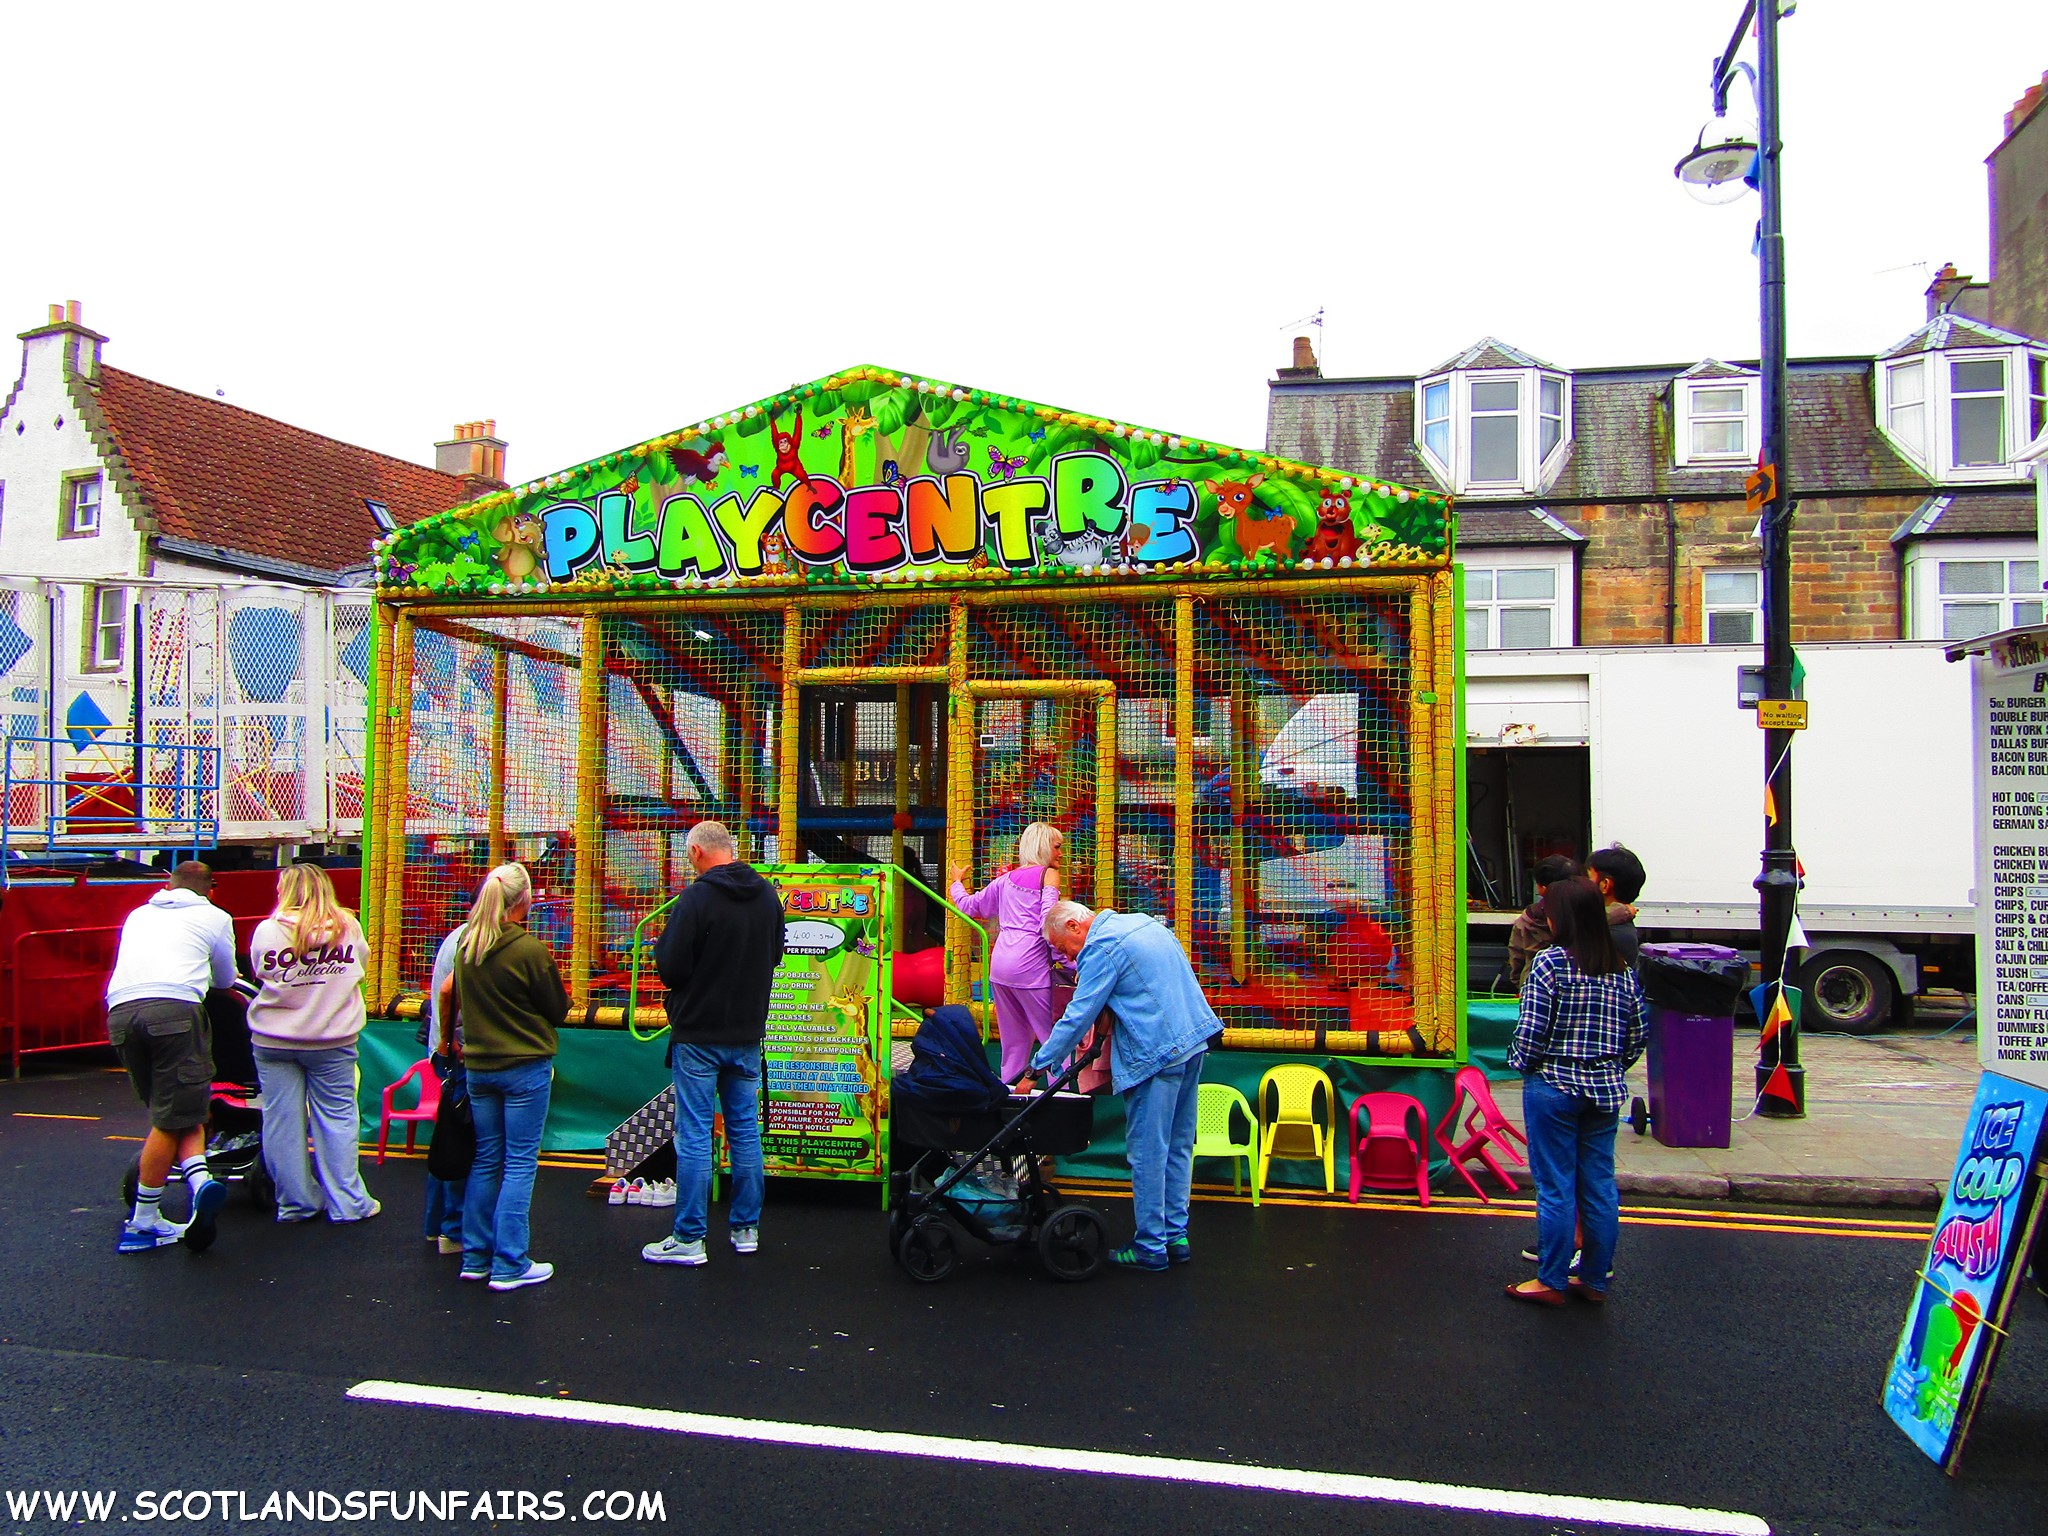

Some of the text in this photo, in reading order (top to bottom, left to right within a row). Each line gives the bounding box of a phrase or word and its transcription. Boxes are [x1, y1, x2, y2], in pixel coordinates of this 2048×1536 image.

[542, 451, 1197, 584] PLAYCENTRE
[2009, 641, 2040, 668] SLUSH
[2007, 697, 2046, 708] BURGER
[1990, 712, 2027, 722] DOUBLE
[1990, 725, 2042, 735] NEW YORK
[1991, 739, 2028, 749] DALLAS
[1991, 752, 2025, 762] BACON
[1992, 765, 2025, 776] BACON
[1992, 792, 2011, 802] HOT
[2015, 792, 2035, 802] DOG
[1992, 805, 2043, 816] FOOTLONG
[1993, 819, 2035, 829] GERMAN
[1993, 846, 2035, 856] CHICKEN
[1994, 859, 2036, 870] CHICKEN
[1994, 872, 2035, 883] NACHOS
[1994, 886, 2024, 897] CHIPS
[1994, 900, 2027, 912] CHIPS,
[1995, 913, 2024, 924] CHIPS
[2028, 914, 2036, 924] &
[1995, 927, 2028, 939] CHIPS,
[1995, 940, 2014, 950] SALT
[2018, 940, 2025, 951] &
[264, 944, 354, 970] SOCIAL
[1996, 954, 2026, 965] CAJUN
[273, 962, 347, 983] Collective
[1996, 967, 2028, 978] SLUSH
[1997, 994, 2024, 1005] CANS
[1997, 1008, 2030, 1019] CANDY
[1998, 1022, 2045, 1034] DUMMIES
[1998, 1035, 2032, 1047] TOFFEE
[1998, 1049, 2027, 1060] MORE
[767, 1061, 856, 1072] ARE RESPONSIBLE FOR
[767, 1071, 861, 1082] CHILDREN AT ALL TIMES
[767, 1082, 869, 1093] LEAVE THEM UNATTENDED
[775, 1101, 816, 1109] ATTENDANT
[1973, 1104, 2023, 1151] ICE
[777, 1137, 799, 1145] THIS
[802, 1139, 863, 1149] PLAYCENTRE
[800, 1148, 857, 1156] ATTENDANT
[1955, 1155, 2022, 1202] COLD
[1931, 1199, 2002, 1276] SLUSH
